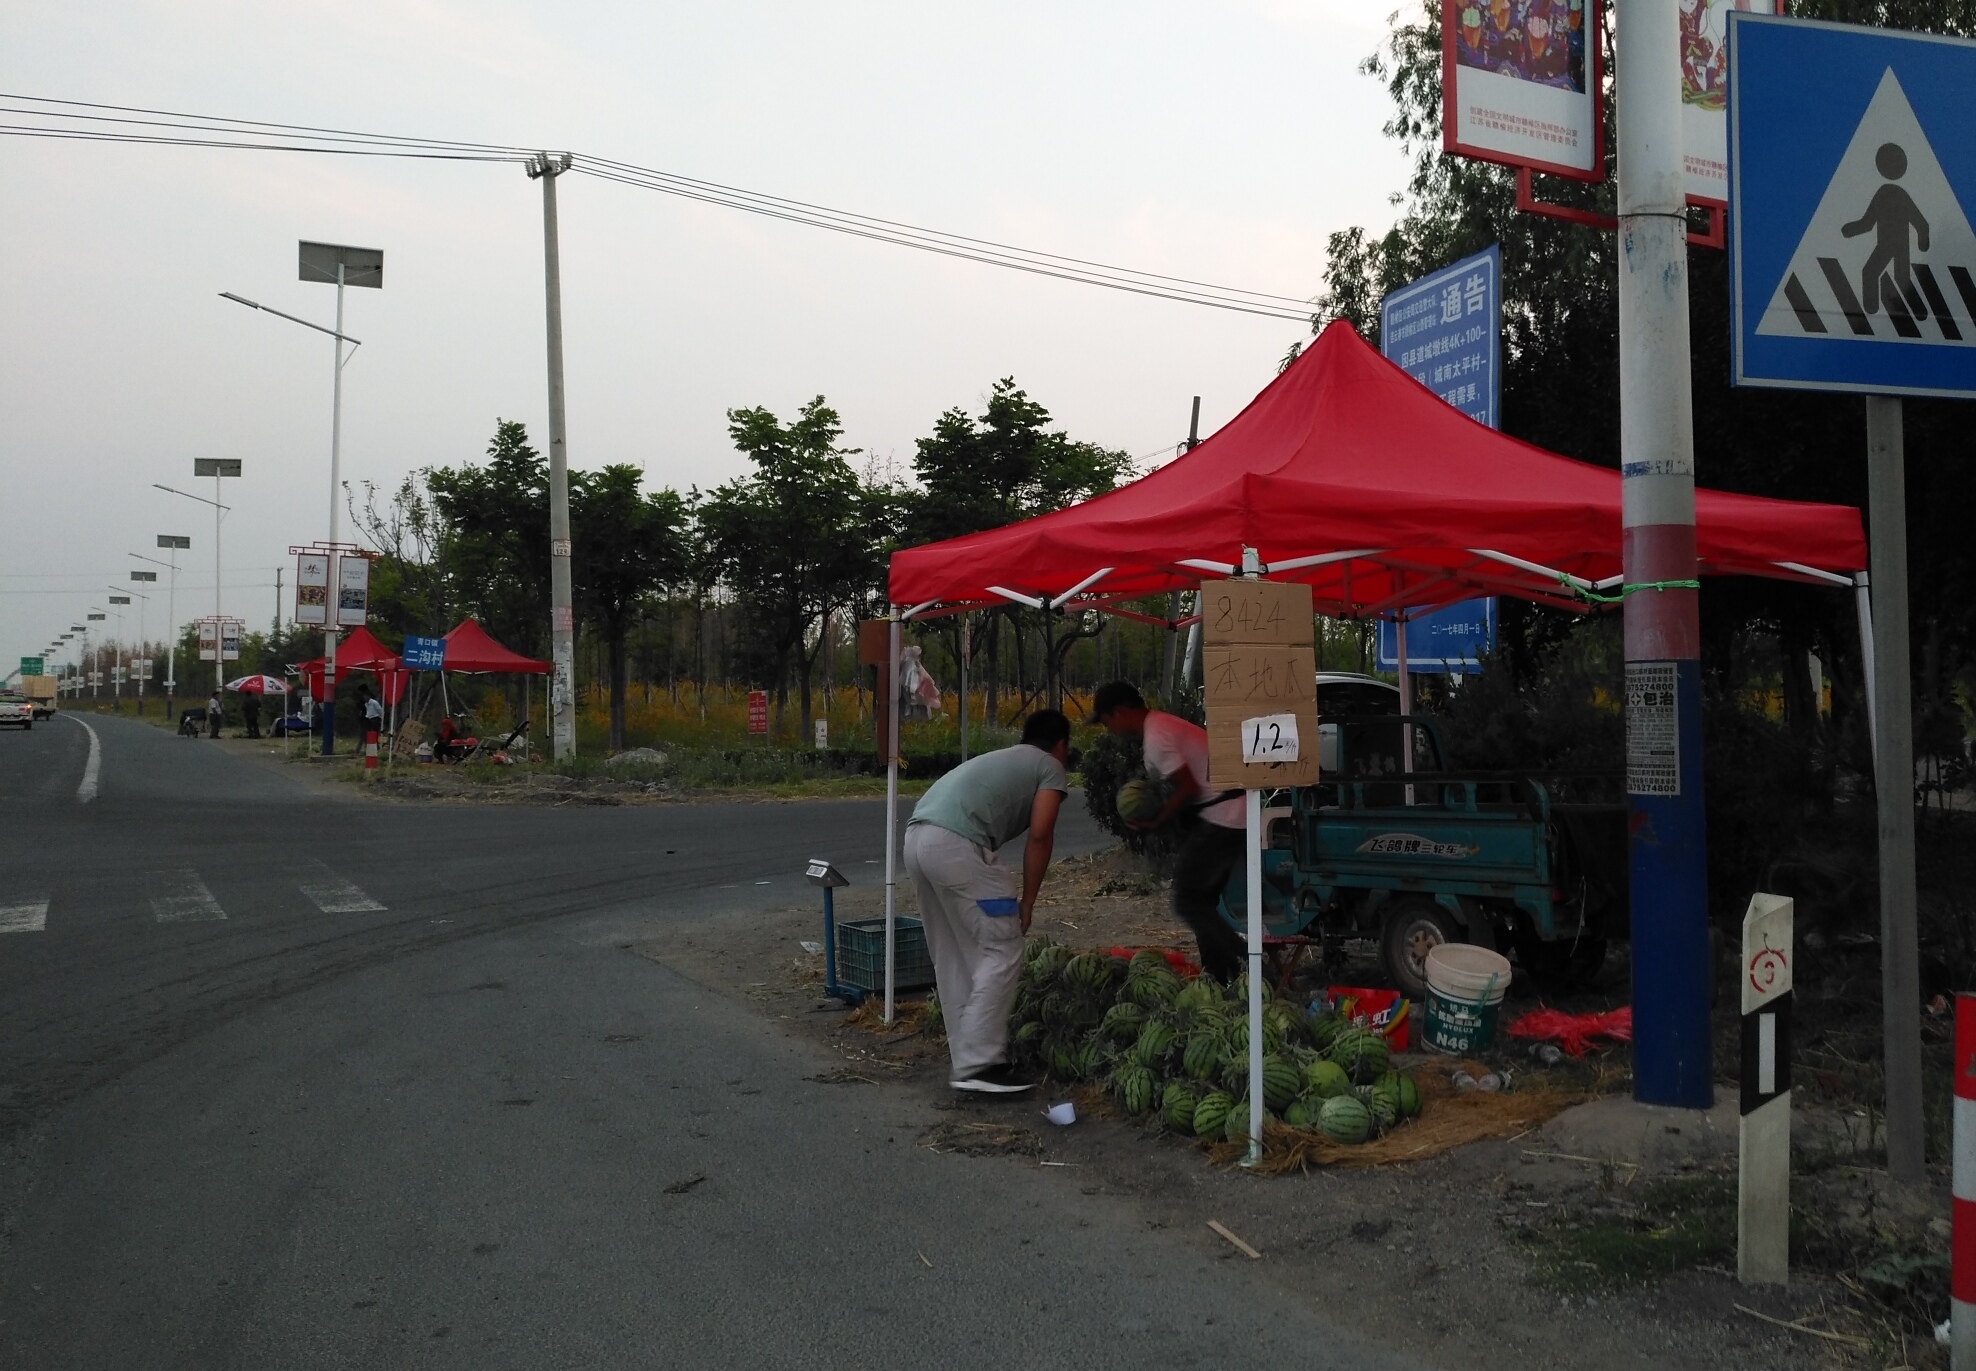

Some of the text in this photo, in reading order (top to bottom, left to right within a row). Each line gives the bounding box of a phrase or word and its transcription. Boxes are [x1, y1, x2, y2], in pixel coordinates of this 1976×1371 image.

[1440, 273, 1487, 326] 通告
[1214, 595, 1286, 637] 8424
[405, 649, 444, 667] 二沟村
[1210, 652, 1306, 702] 本地瓜
[1370, 839, 1458, 854] 飞鸽牌三轮车
[1436, 1030, 1469, 1051] N46
